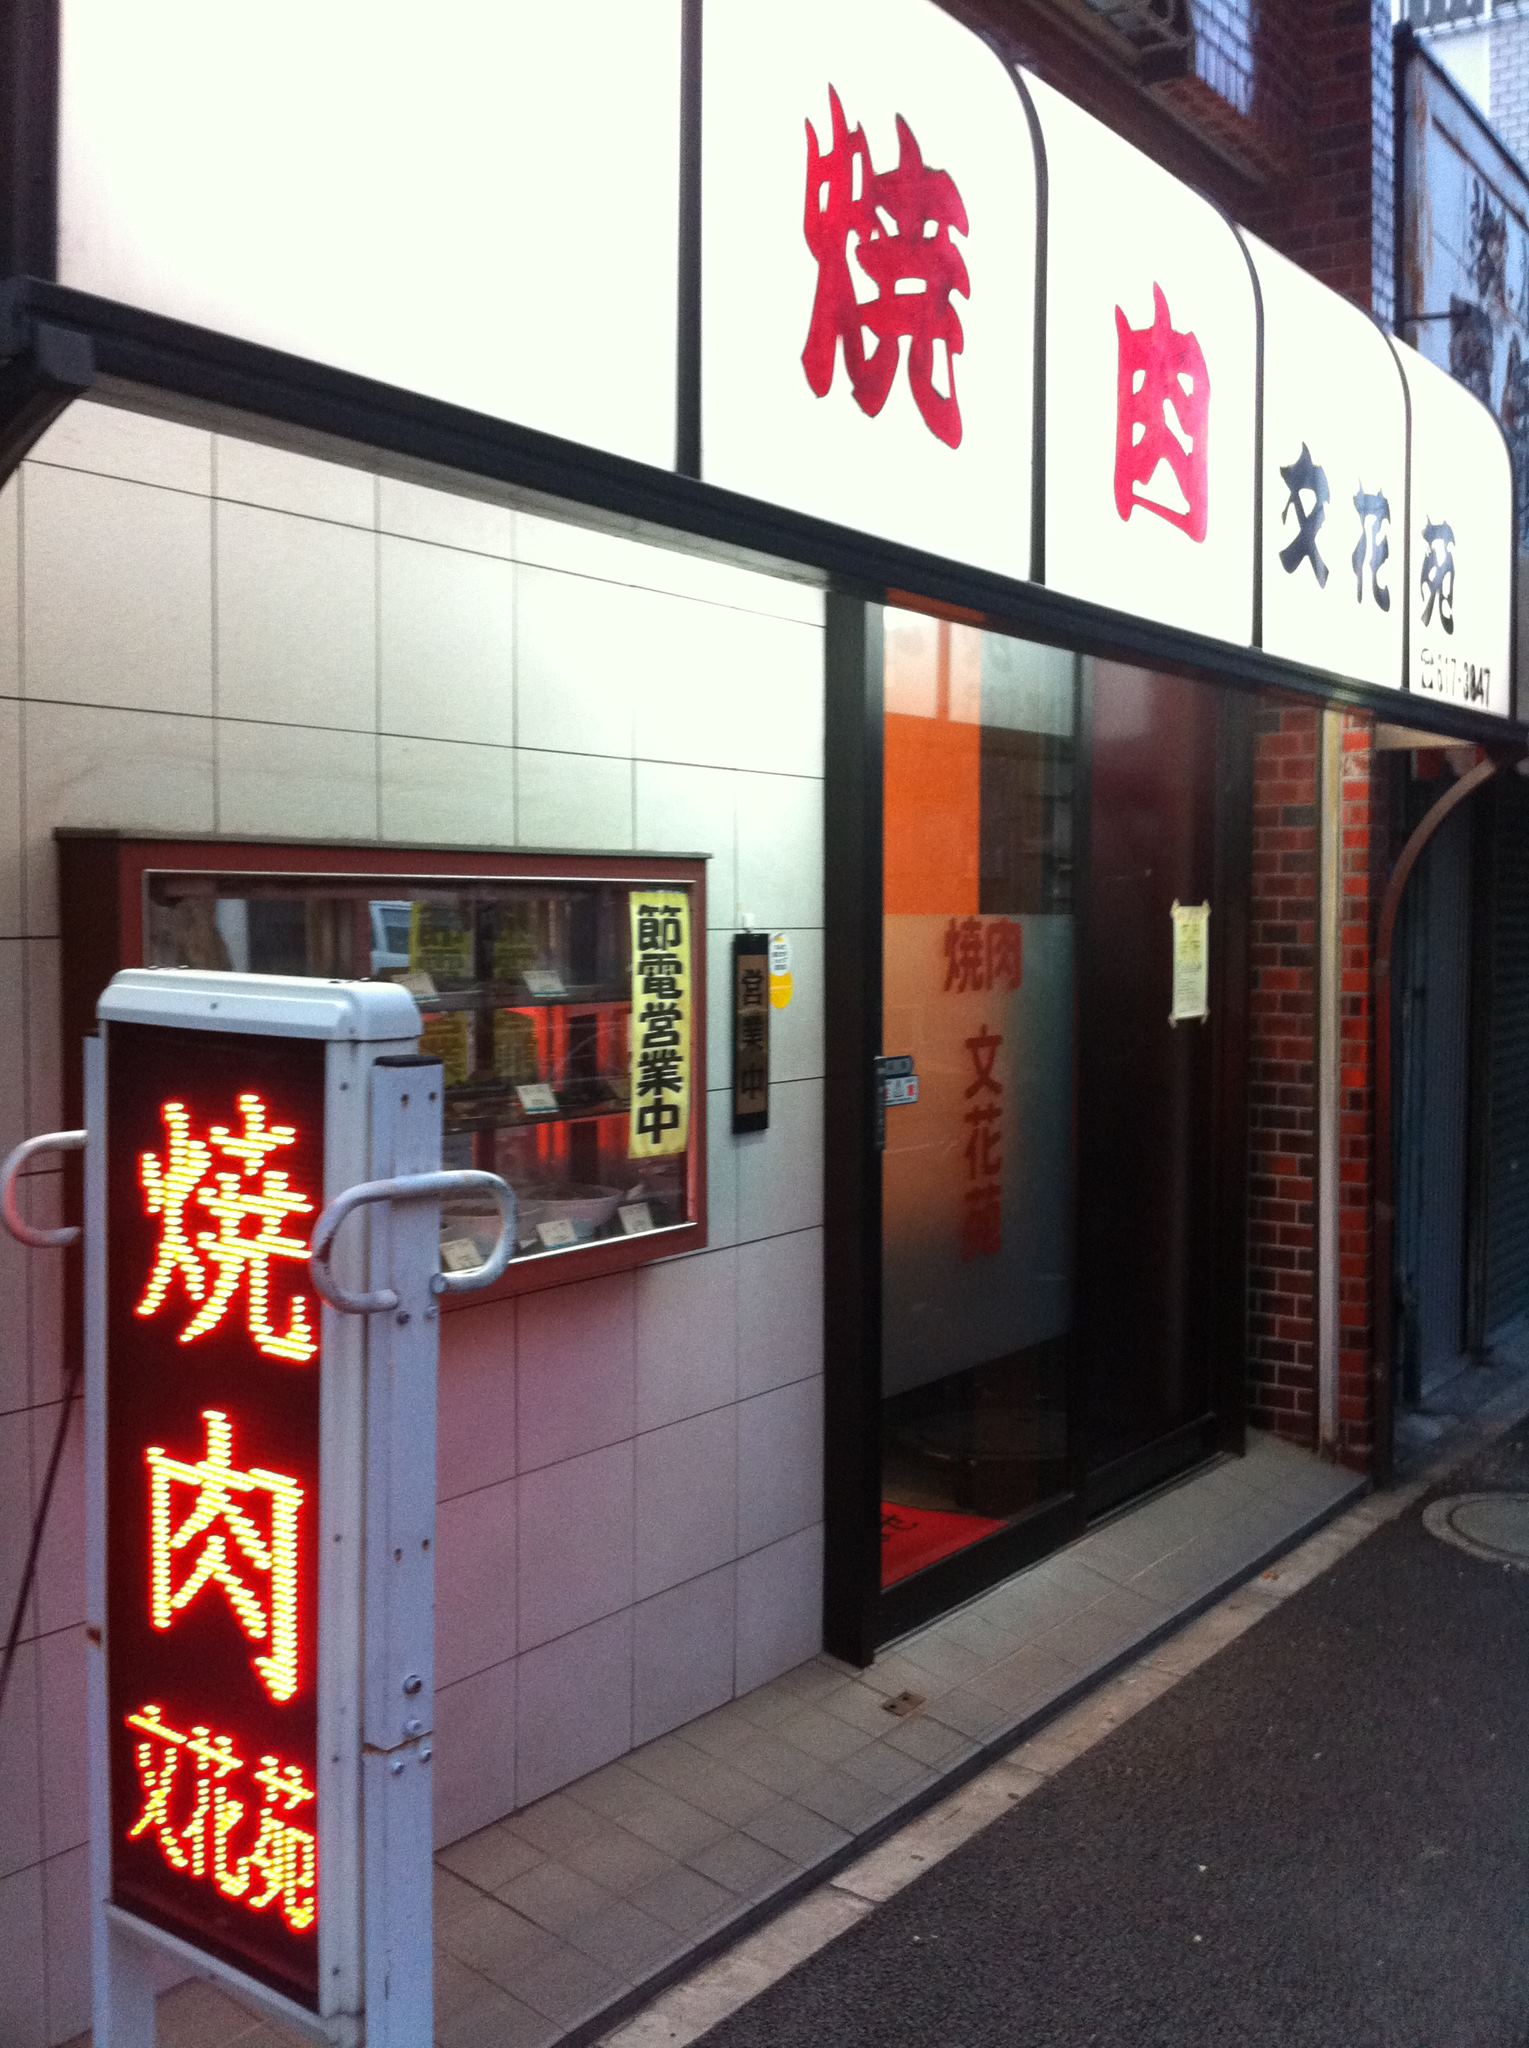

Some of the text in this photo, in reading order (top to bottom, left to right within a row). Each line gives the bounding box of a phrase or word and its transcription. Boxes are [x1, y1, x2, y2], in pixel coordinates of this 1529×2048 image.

[1279, 441, 1455, 635] 文花苑
[637, 905, 684, 1145] 節電営業中
[741, 968, 764, 1100] 営業中
[135, 1092, 319, 1702] 焼肉
[127, 1703, 317, 1932] 文花苑
